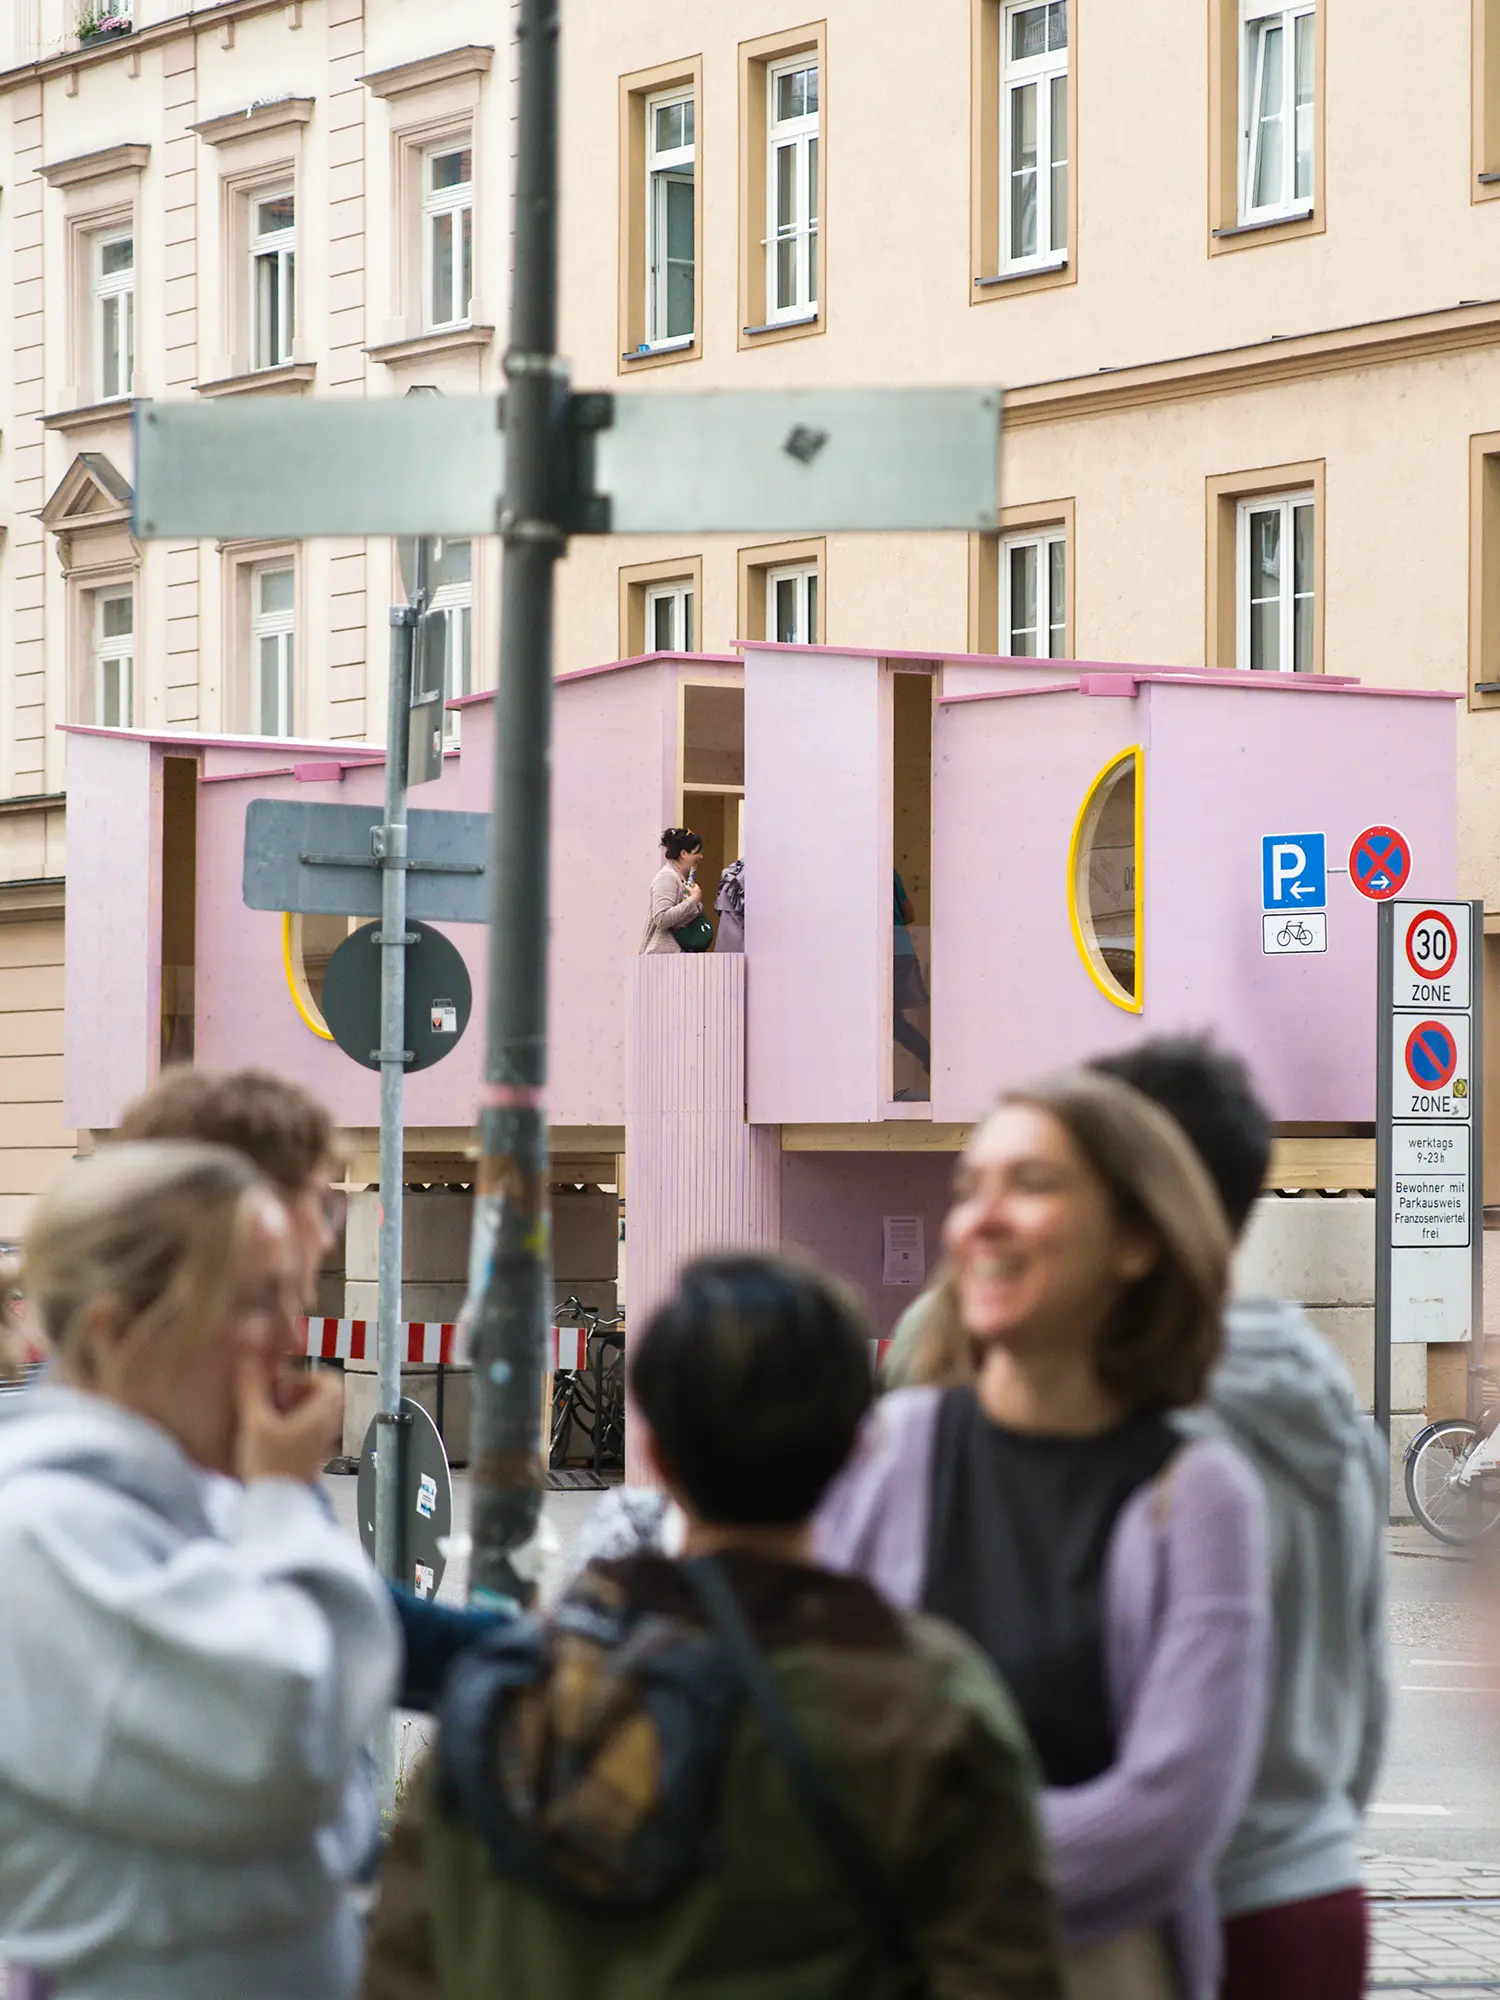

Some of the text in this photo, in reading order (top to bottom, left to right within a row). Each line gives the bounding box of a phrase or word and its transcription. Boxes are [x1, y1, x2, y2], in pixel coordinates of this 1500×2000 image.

[1416, 929, 1446, 960] 30
[1412, 985, 1451, 1001] ZONE
[1411, 1095, 1450, 1112] ZONE
[1408, 1137, 1453, 1151] werktags
[1395, 1181, 1465, 1193] Bewohner mit
[1399, 1197, 1461, 1208] Parkausweis
[1395, 1212, 1466, 1223] Franzosenviertel
[1422, 1228, 1439, 1239] frei
